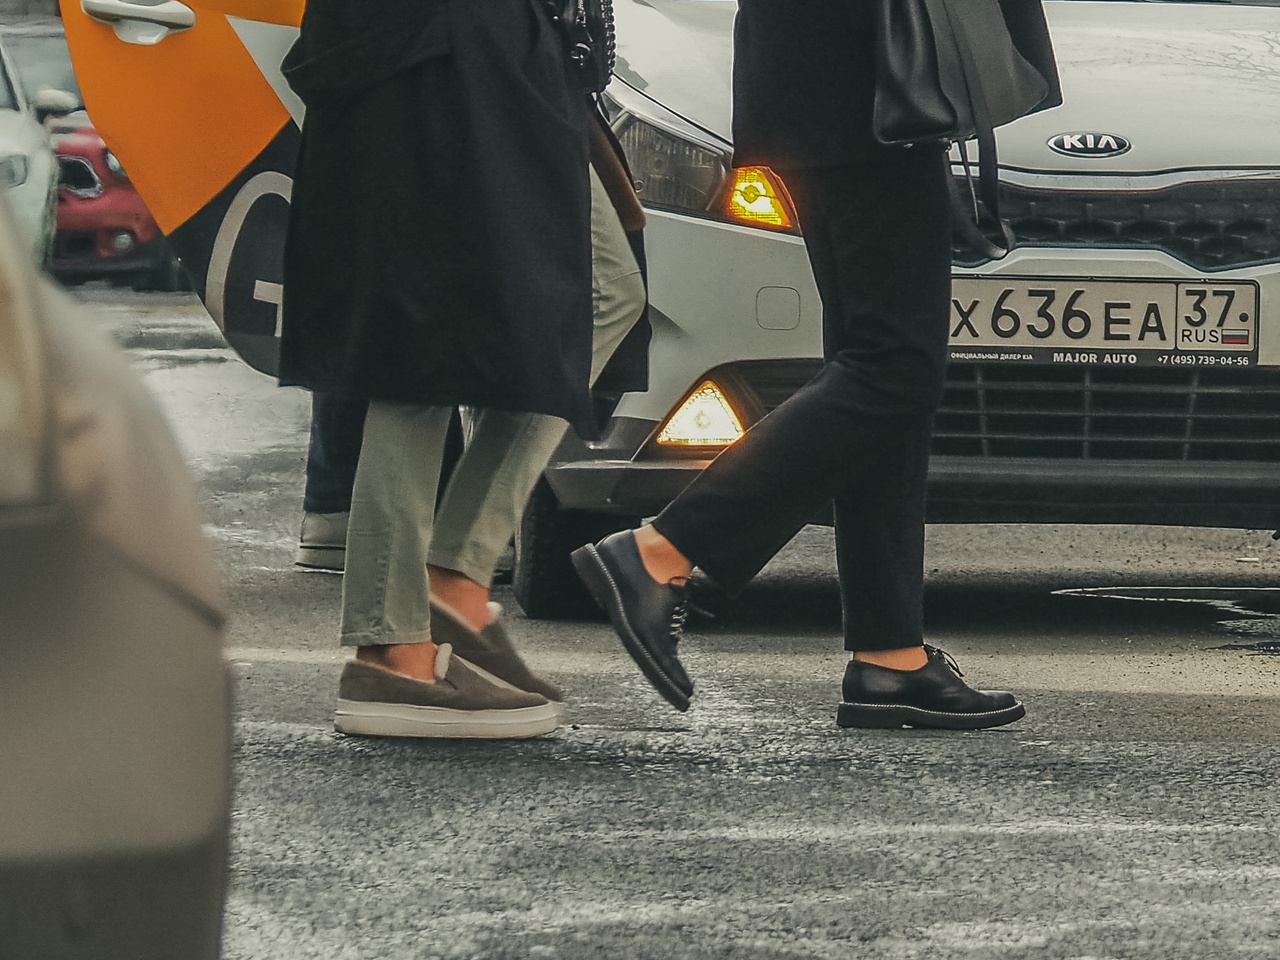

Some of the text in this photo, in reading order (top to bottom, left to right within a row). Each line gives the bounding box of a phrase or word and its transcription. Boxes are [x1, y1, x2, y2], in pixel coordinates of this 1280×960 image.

[1062, 134, 1119, 150] KIA
[1184, 289, 1236, 328] 37
[1181, 329, 1220, 343] RUS
[999, 353, 1022, 361] ДИЛЕР
[1053, 352, 1137, 364] MAJOR AUTO
[1157, 355, 1249, 366] +7 (495) 739-04-56
